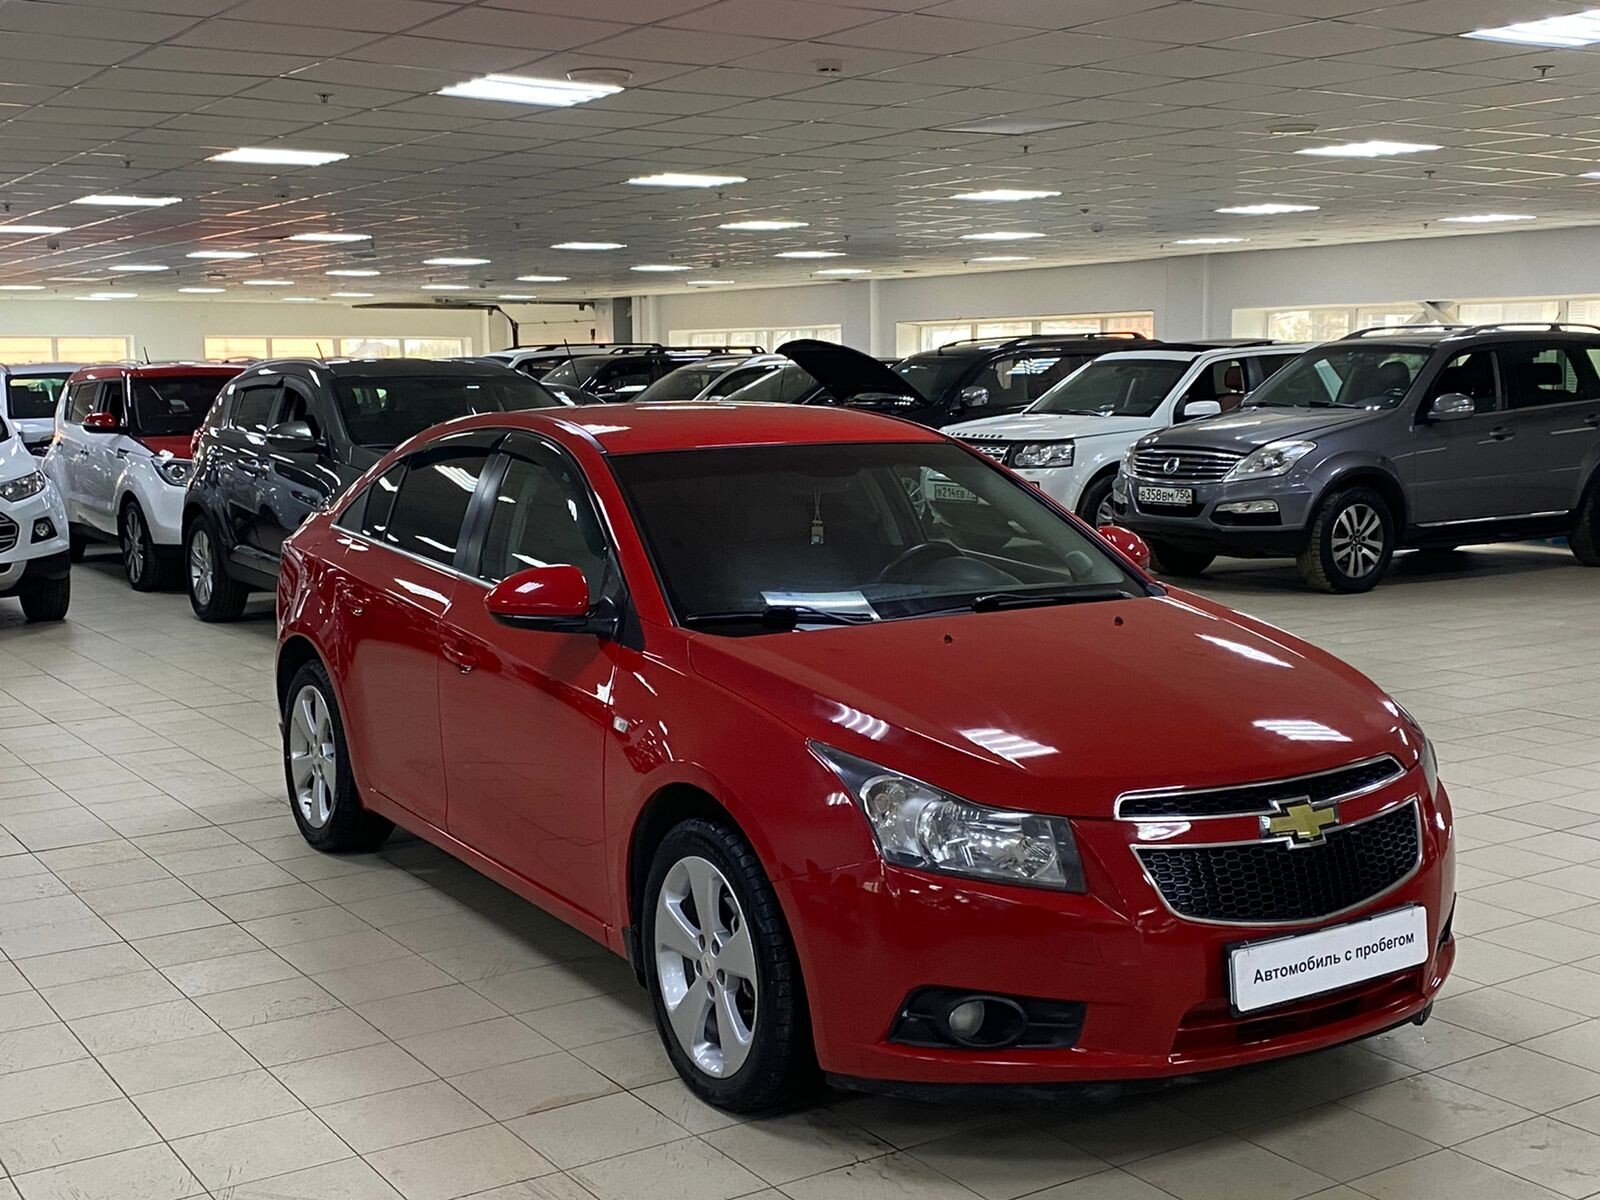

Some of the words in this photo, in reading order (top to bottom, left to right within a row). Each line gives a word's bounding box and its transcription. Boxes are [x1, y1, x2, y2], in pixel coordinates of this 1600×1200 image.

[1140, 488, 1174, 501] В358ВМ
[1175, 489, 1190, 499] 750
[1253, 955, 1341, 984] Автомобиль
[1344, 950, 1352, 961] с
[1355, 932, 1415, 960] пробегом
